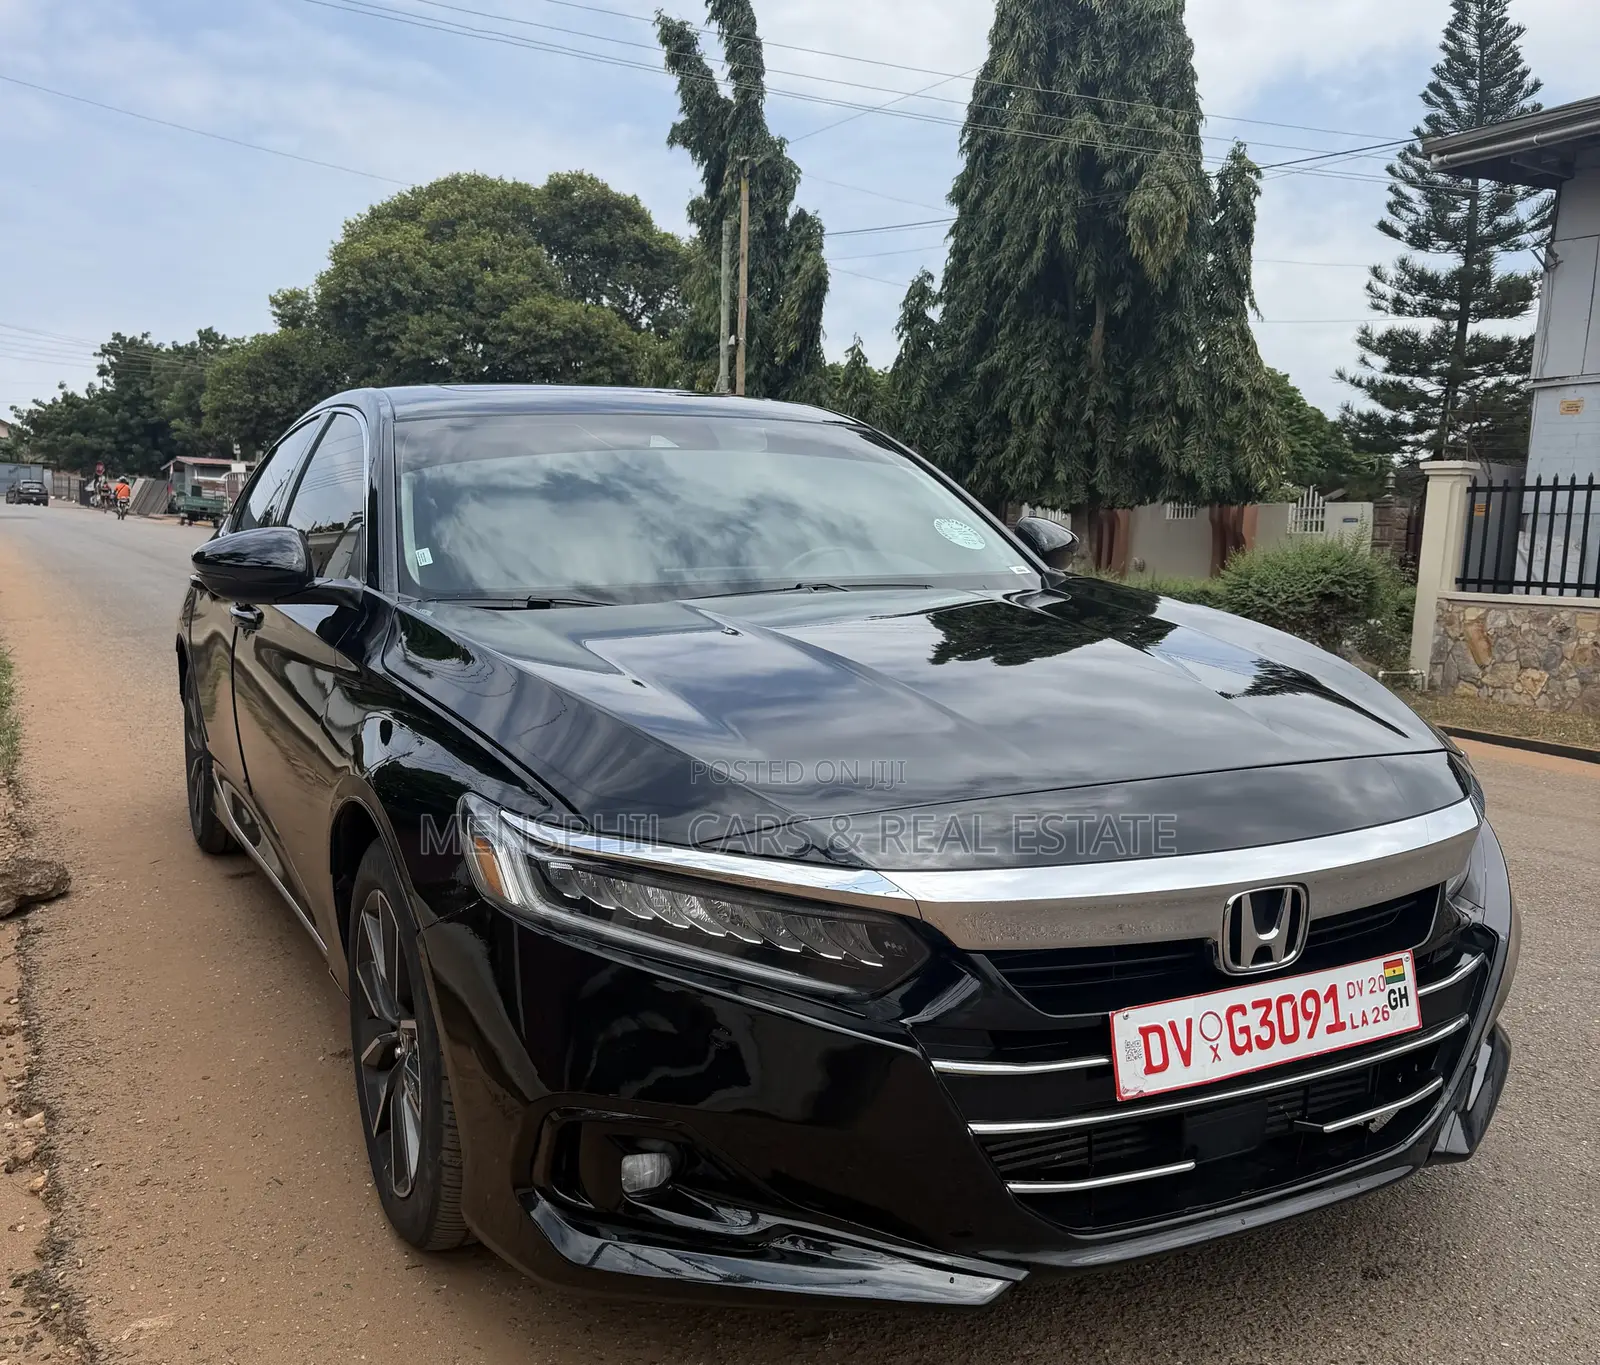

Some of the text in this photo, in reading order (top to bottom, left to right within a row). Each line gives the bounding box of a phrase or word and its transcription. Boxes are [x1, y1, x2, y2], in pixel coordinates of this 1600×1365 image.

[1346, 974, 1386, 1000] DV 20
[1387, 985, 1410, 1011] GH
[1138, 984, 1346, 1075] DV G3091
[1349, 1004, 1391, 1030] LA 26
